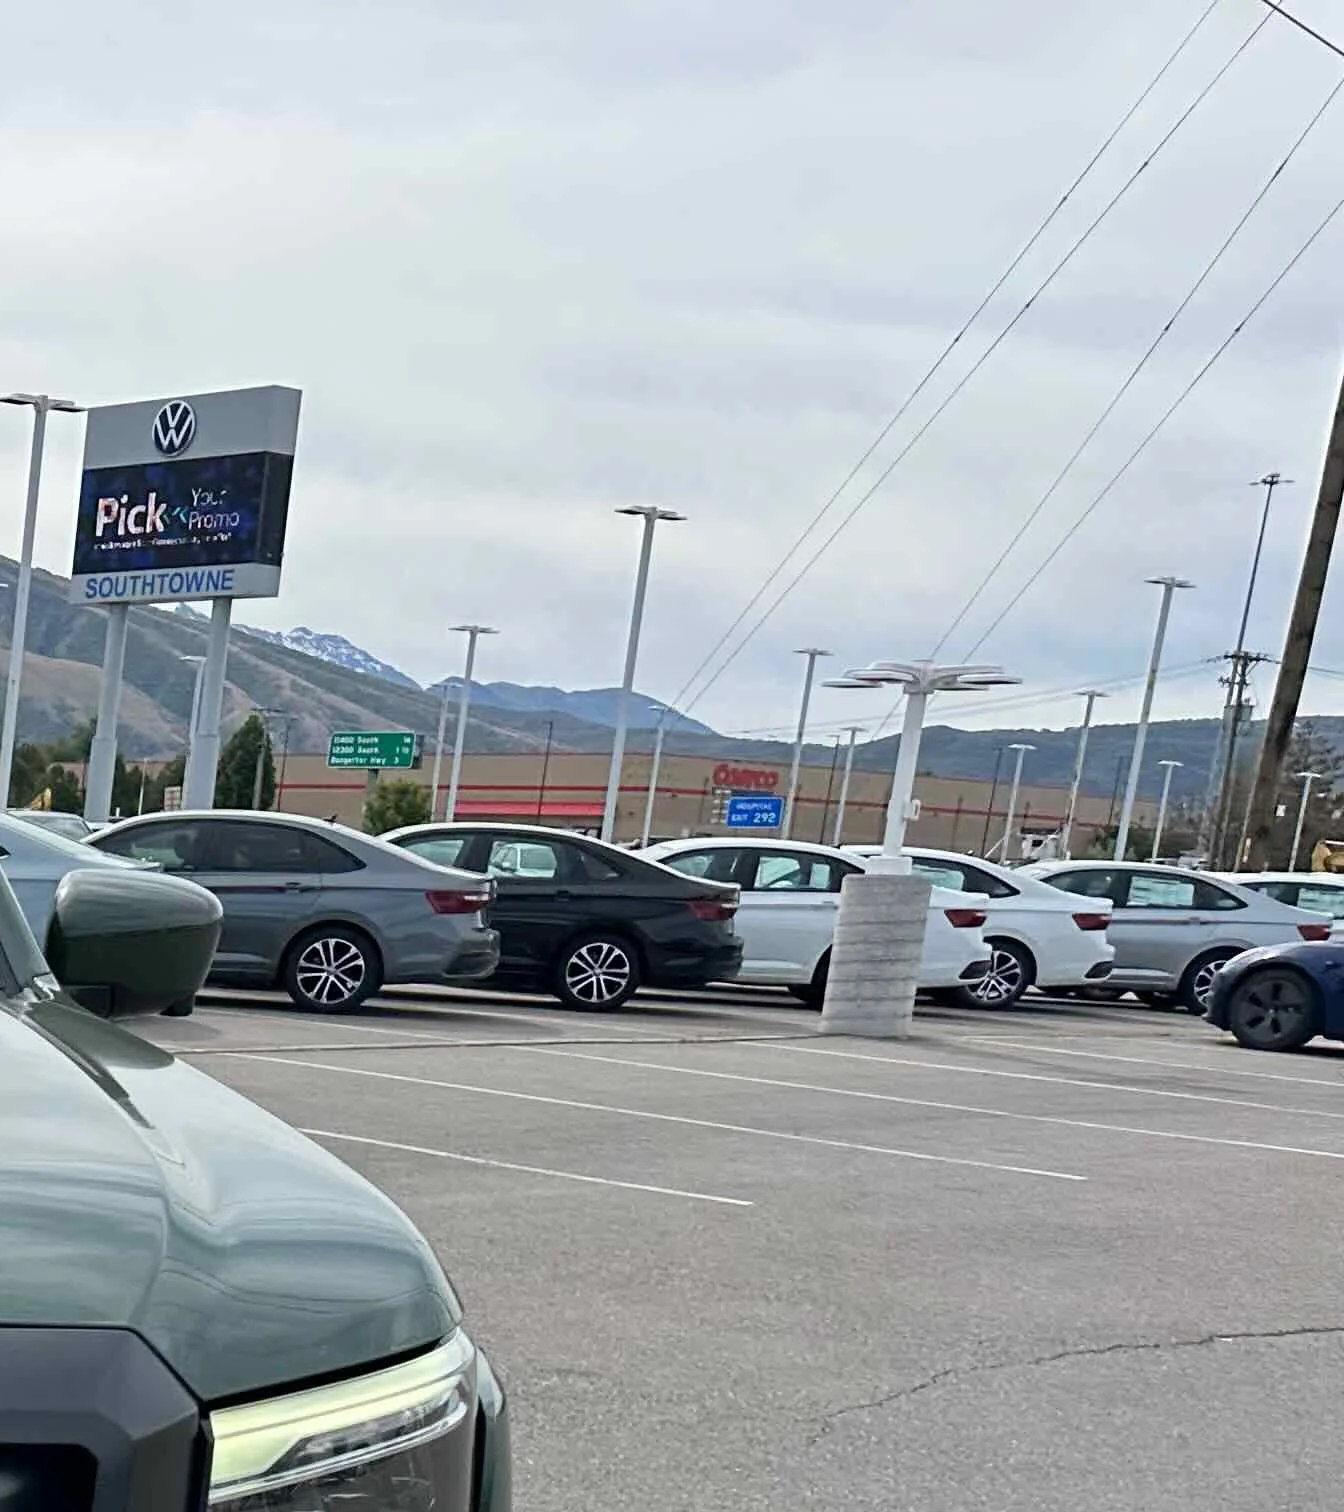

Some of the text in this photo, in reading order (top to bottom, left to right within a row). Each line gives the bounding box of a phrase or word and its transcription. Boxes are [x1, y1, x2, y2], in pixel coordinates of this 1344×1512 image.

[95, 492, 167, 537] Pick
[188, 511, 240, 530] Promo
[85, 569, 236, 600] SOUTHTOWNE
[753, 812, 777, 823] 292
